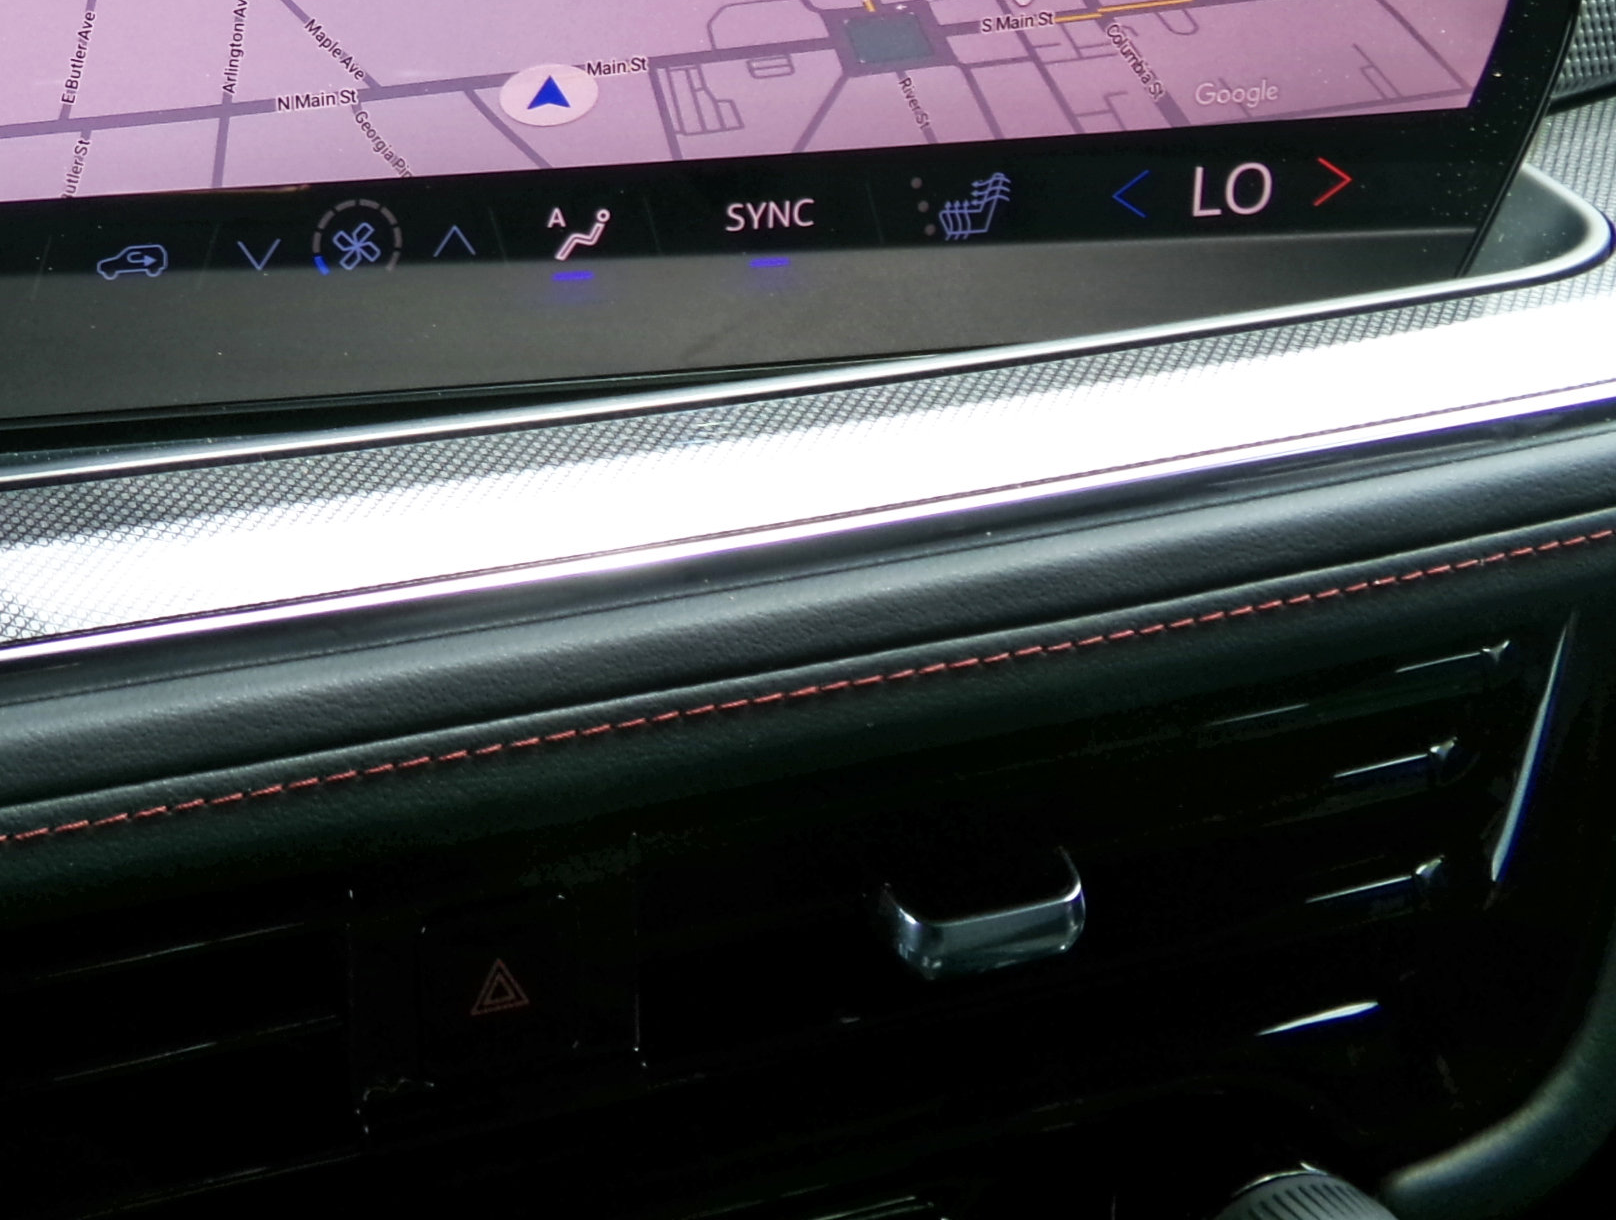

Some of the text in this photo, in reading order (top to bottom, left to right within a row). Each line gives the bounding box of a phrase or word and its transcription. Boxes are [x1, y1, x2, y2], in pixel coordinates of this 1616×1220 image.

[982, 12, 1054, 33] S Main St
[61, 12, 95, 104] E Butler Ave
[223, 22, 245, 94] Arlington
[305, 19, 364, 80] Maple Ave
[587, 57, 646, 76] Main St
[1106, 24, 1166, 101] Columbia St
[278, 89, 357, 110] N Main St
[899, 77, 931, 130] River St
[1195, 80, 1279, 108] Google
[74, 139, 90, 156] St
[355, 111, 394, 162] Georgia
[1192, 162, 1273, 217] LO
[547, 207, 566, 228] A
[726, 199, 814, 233] SYNC
